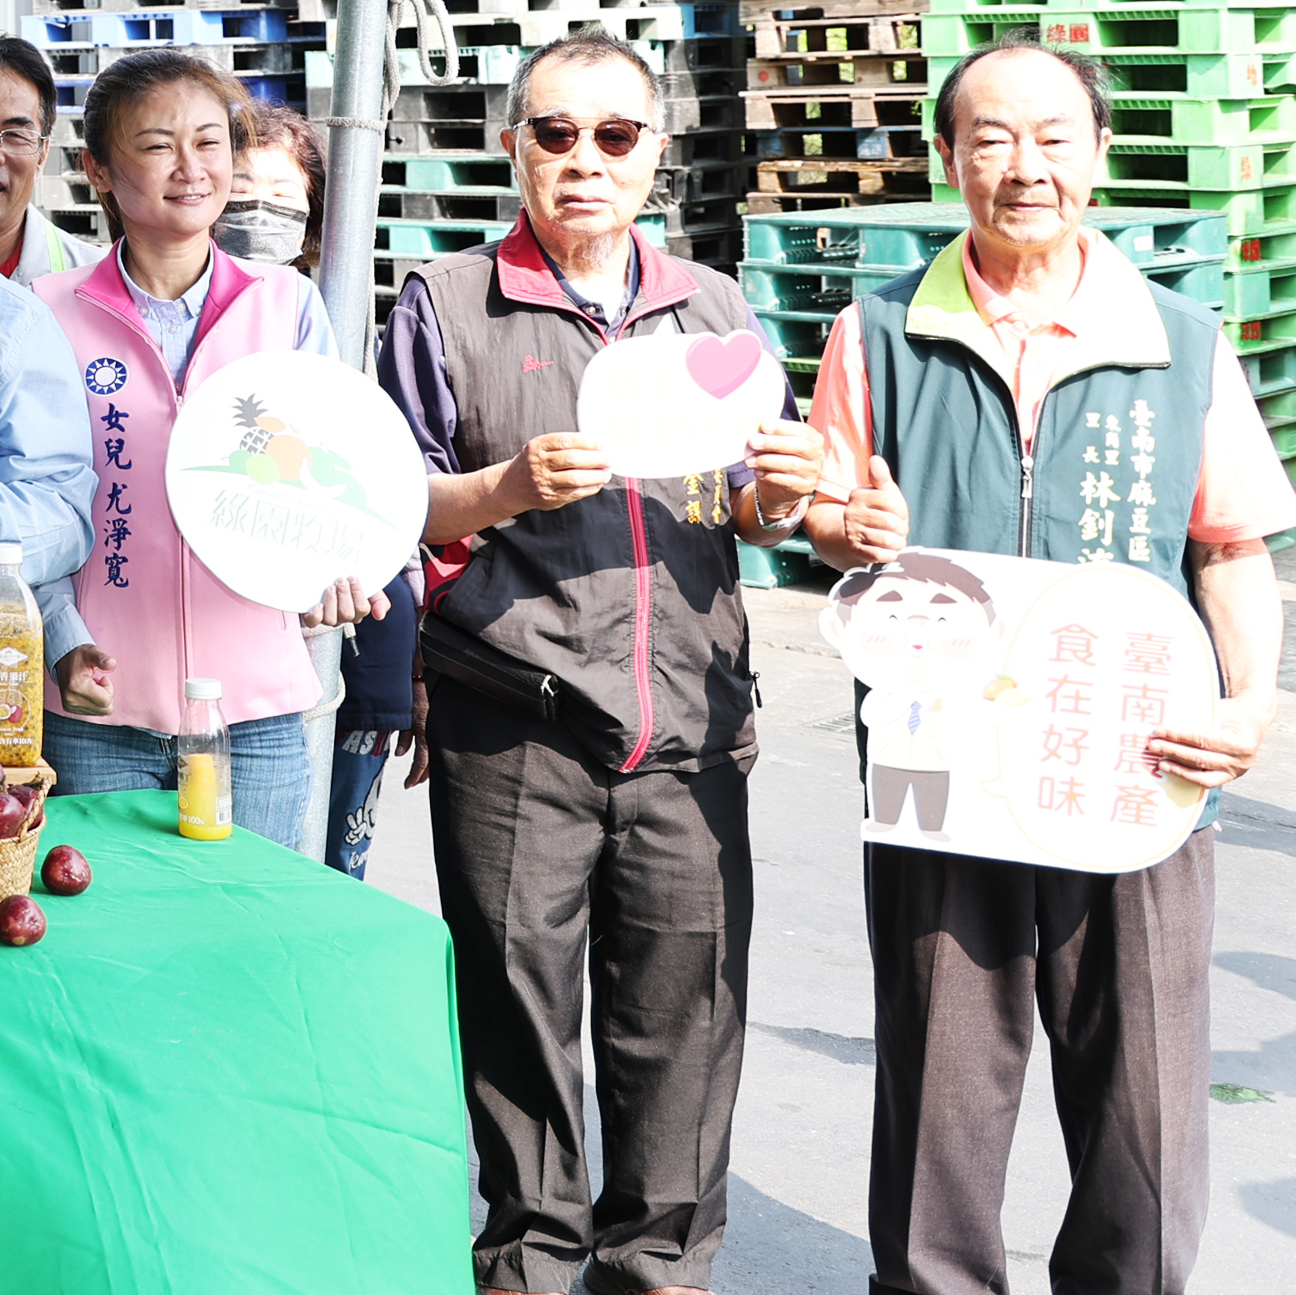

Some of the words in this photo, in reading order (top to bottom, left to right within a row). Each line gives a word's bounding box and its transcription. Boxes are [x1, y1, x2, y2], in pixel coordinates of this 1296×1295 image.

[209, 489, 364, 566] 綠園牧場
[1127, 398, 1158, 562] 臺南市麻豆區
[1037, 623, 1100, 818] 食在好味
[1108, 630, 1175, 829] 臺南農產
